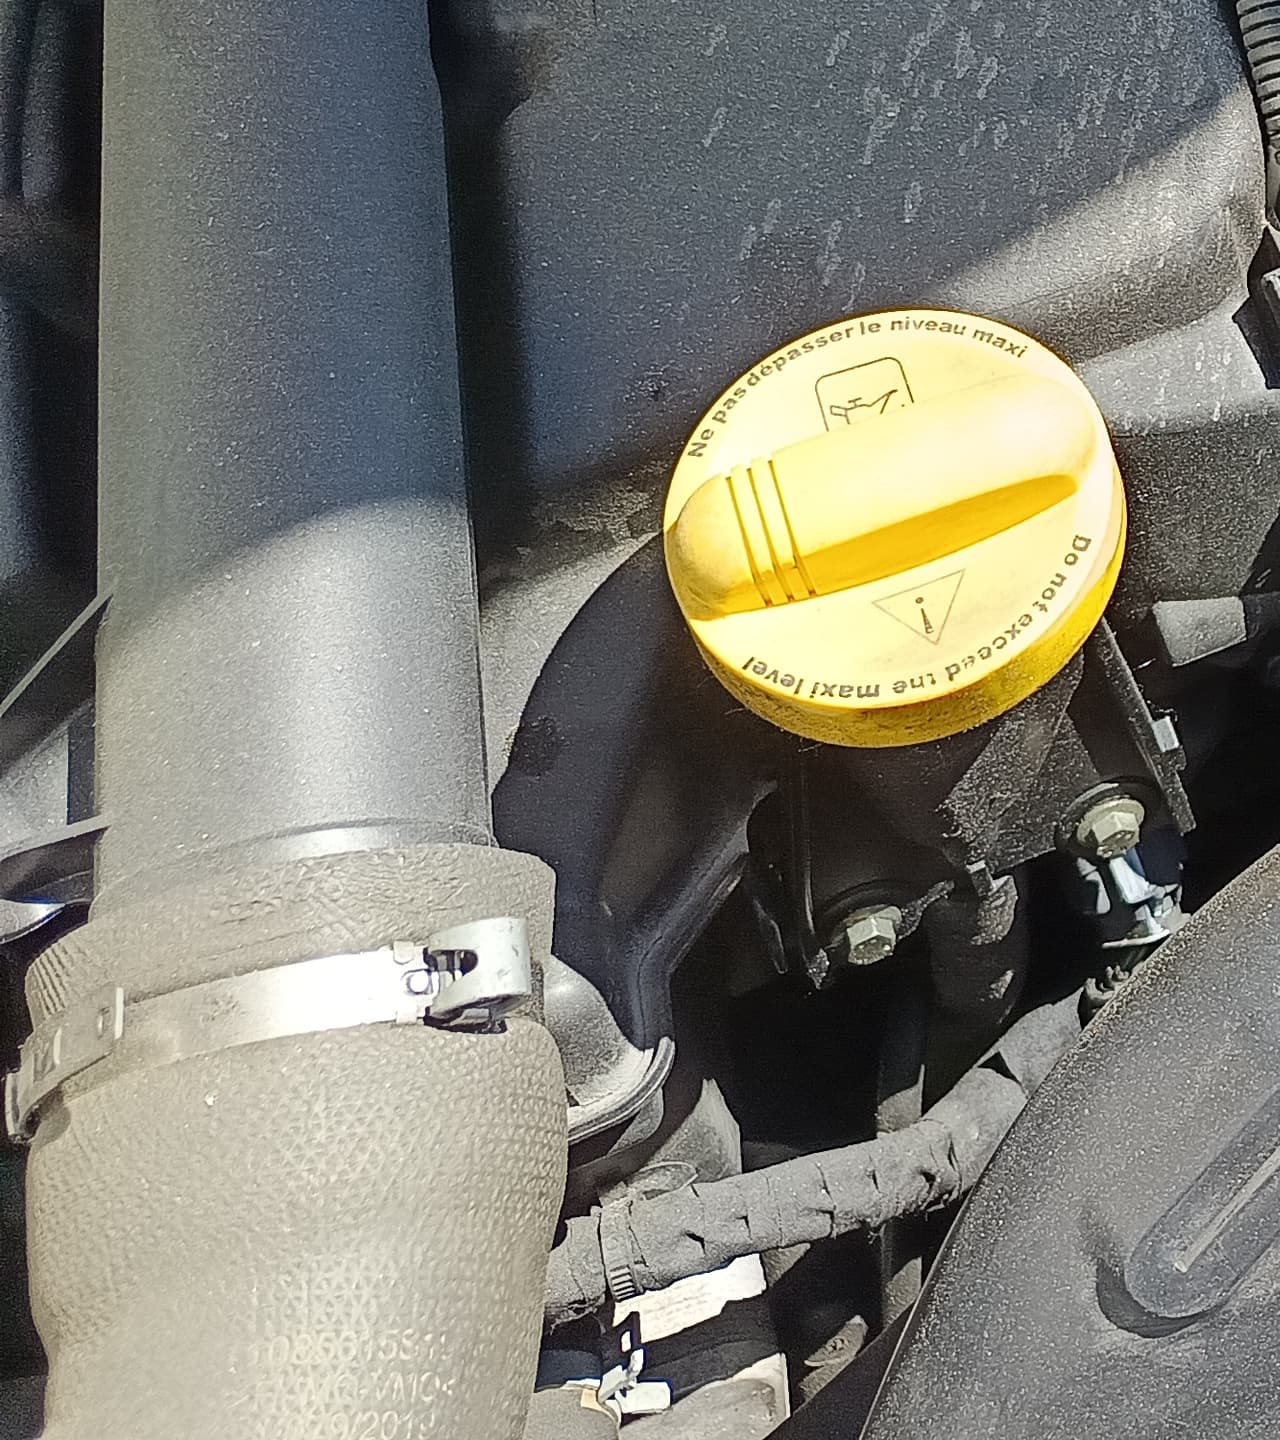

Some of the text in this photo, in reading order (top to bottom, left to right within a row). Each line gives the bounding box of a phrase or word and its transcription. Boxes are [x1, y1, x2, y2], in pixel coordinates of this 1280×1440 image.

[687, 315, 1030, 458] Ne pas dépasser le niveau maxi
[1063, 534, 1092, 567] Do
[1030, 574, 1067, 613] not
[943, 611, 1034, 683] exceed
[742, 656, 804, 697] level
[808, 680, 881, 700] maxi
